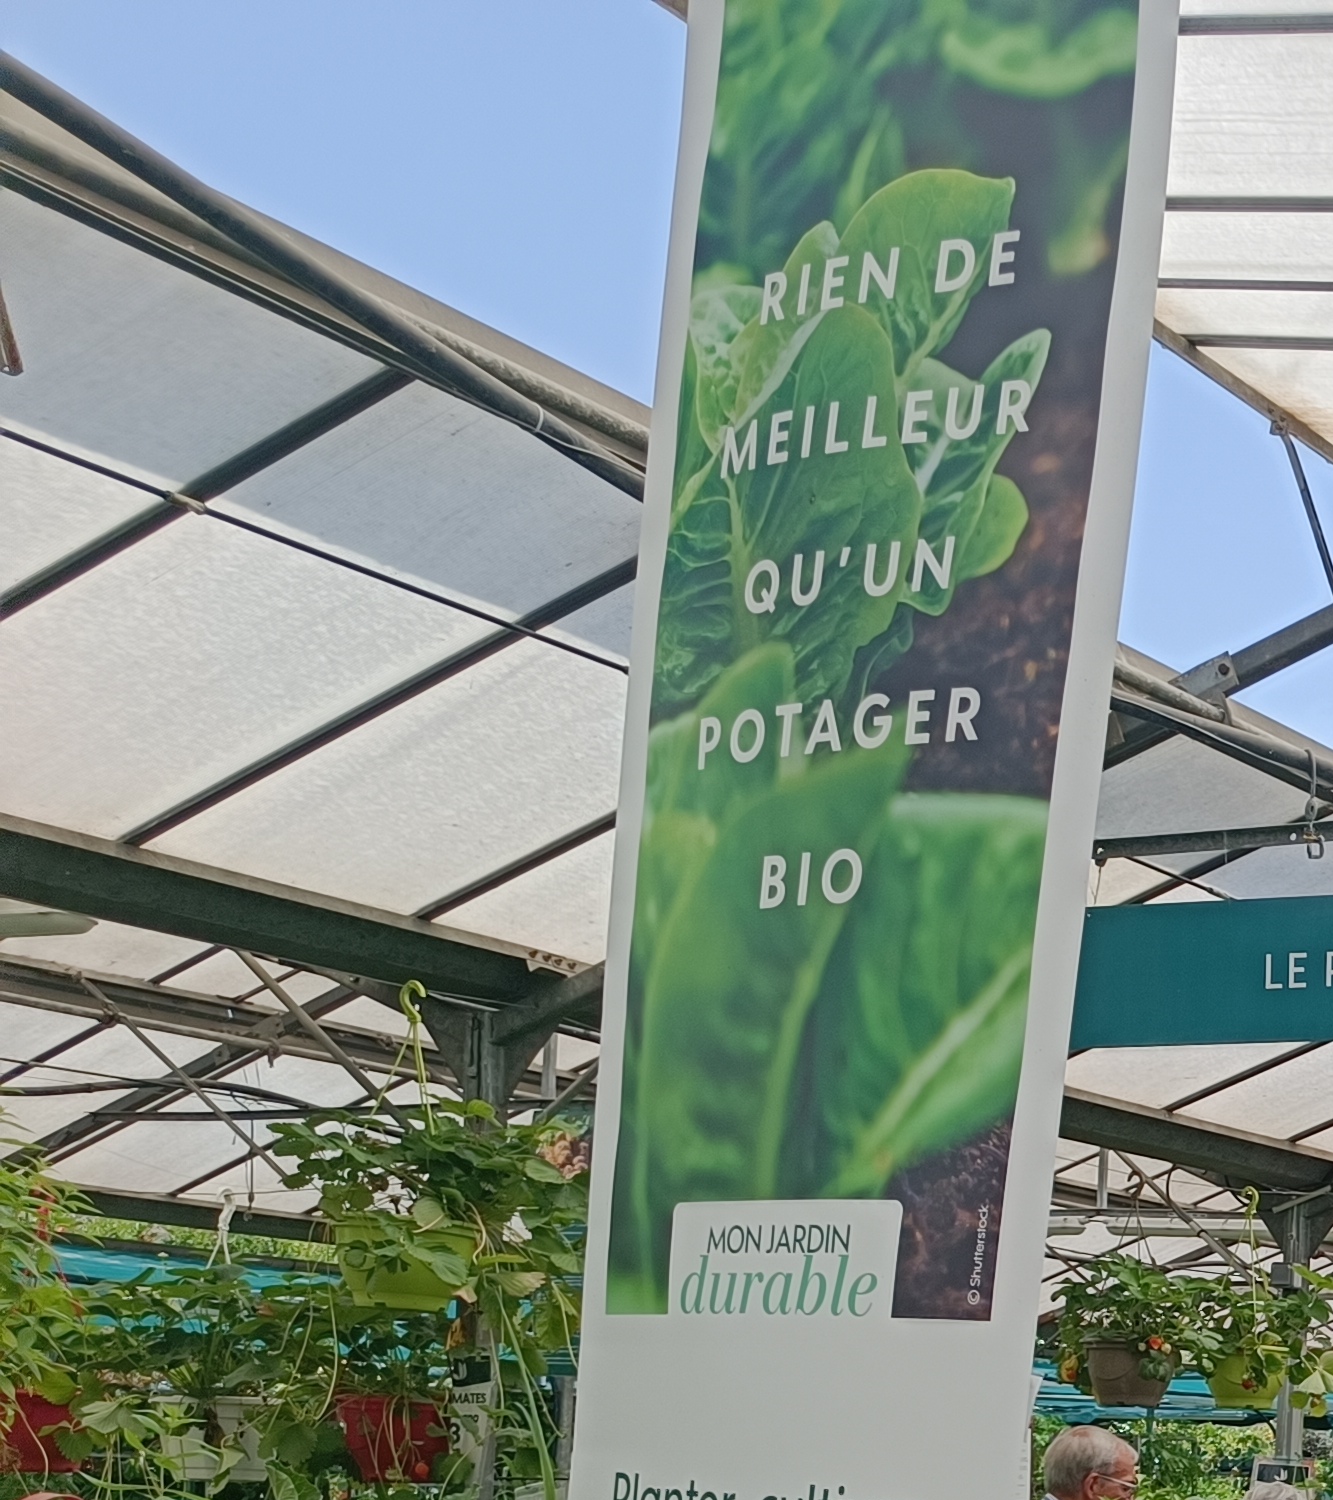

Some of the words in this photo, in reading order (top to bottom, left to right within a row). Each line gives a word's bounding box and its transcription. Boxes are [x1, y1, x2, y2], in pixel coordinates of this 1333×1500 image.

[759, 247, 899, 326] RIEN
[934, 230, 1021, 294] DE
[720, 379, 1030, 480] MEILLEUR
[743, 534, 956, 615] QU'UN
[697, 687, 981, 771] POTAGER
[758, 847, 864, 910] BIO
[1264, 952, 1307, 989] LE
[706, 1225, 764, 1255] MON
[766, 1223, 852, 1256] JARDIN
[680, 1253, 879, 1318] durable
